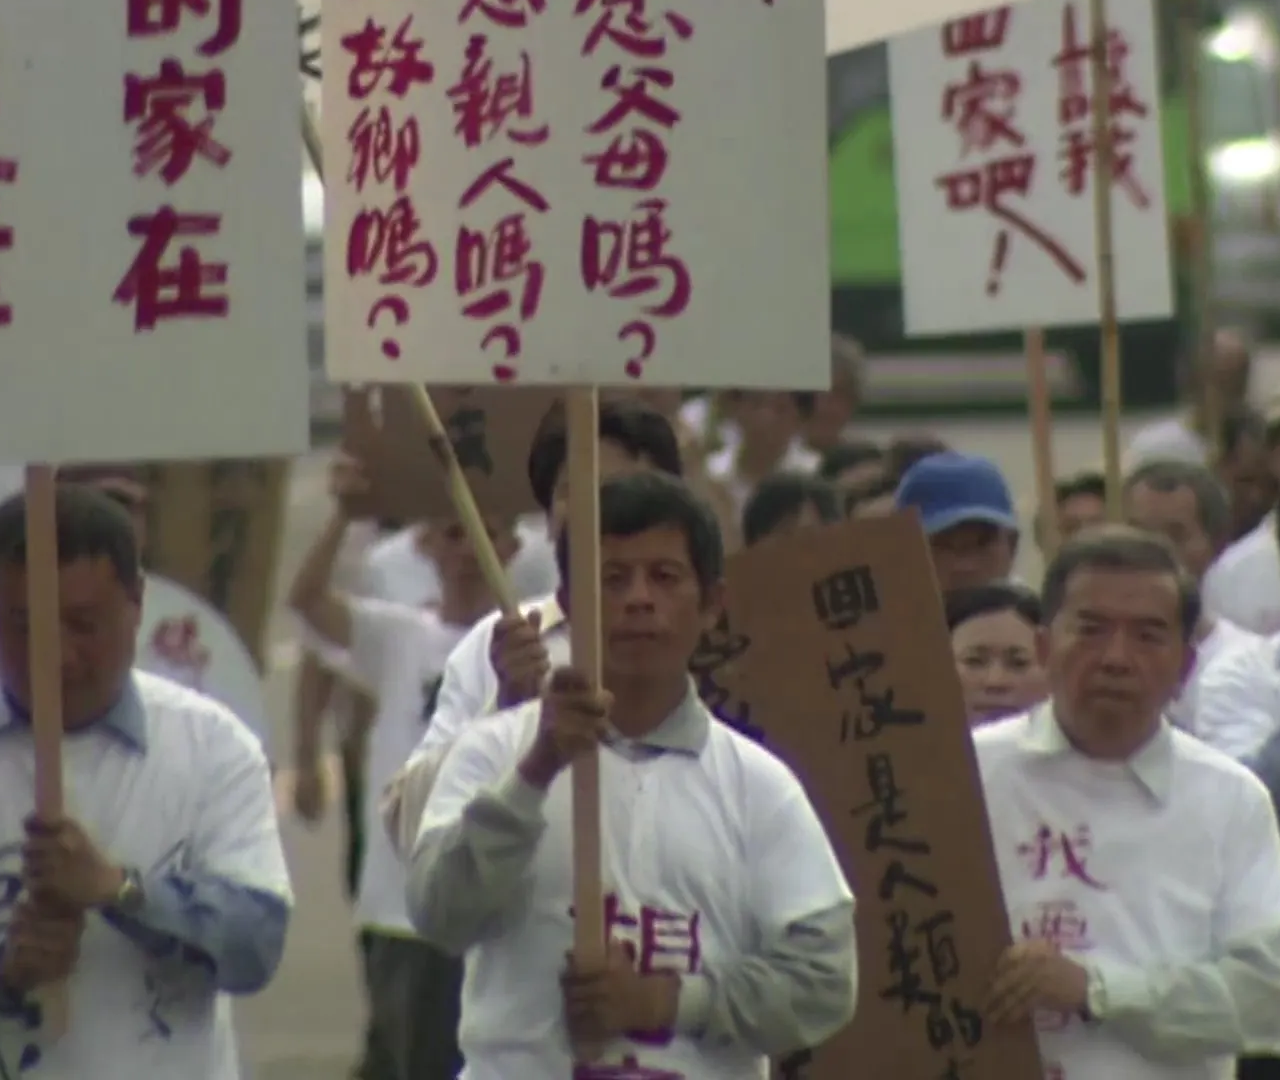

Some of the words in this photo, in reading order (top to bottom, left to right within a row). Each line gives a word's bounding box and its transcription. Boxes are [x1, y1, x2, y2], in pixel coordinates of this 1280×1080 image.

[812, 565, 985, 1080] 回家是人類的
